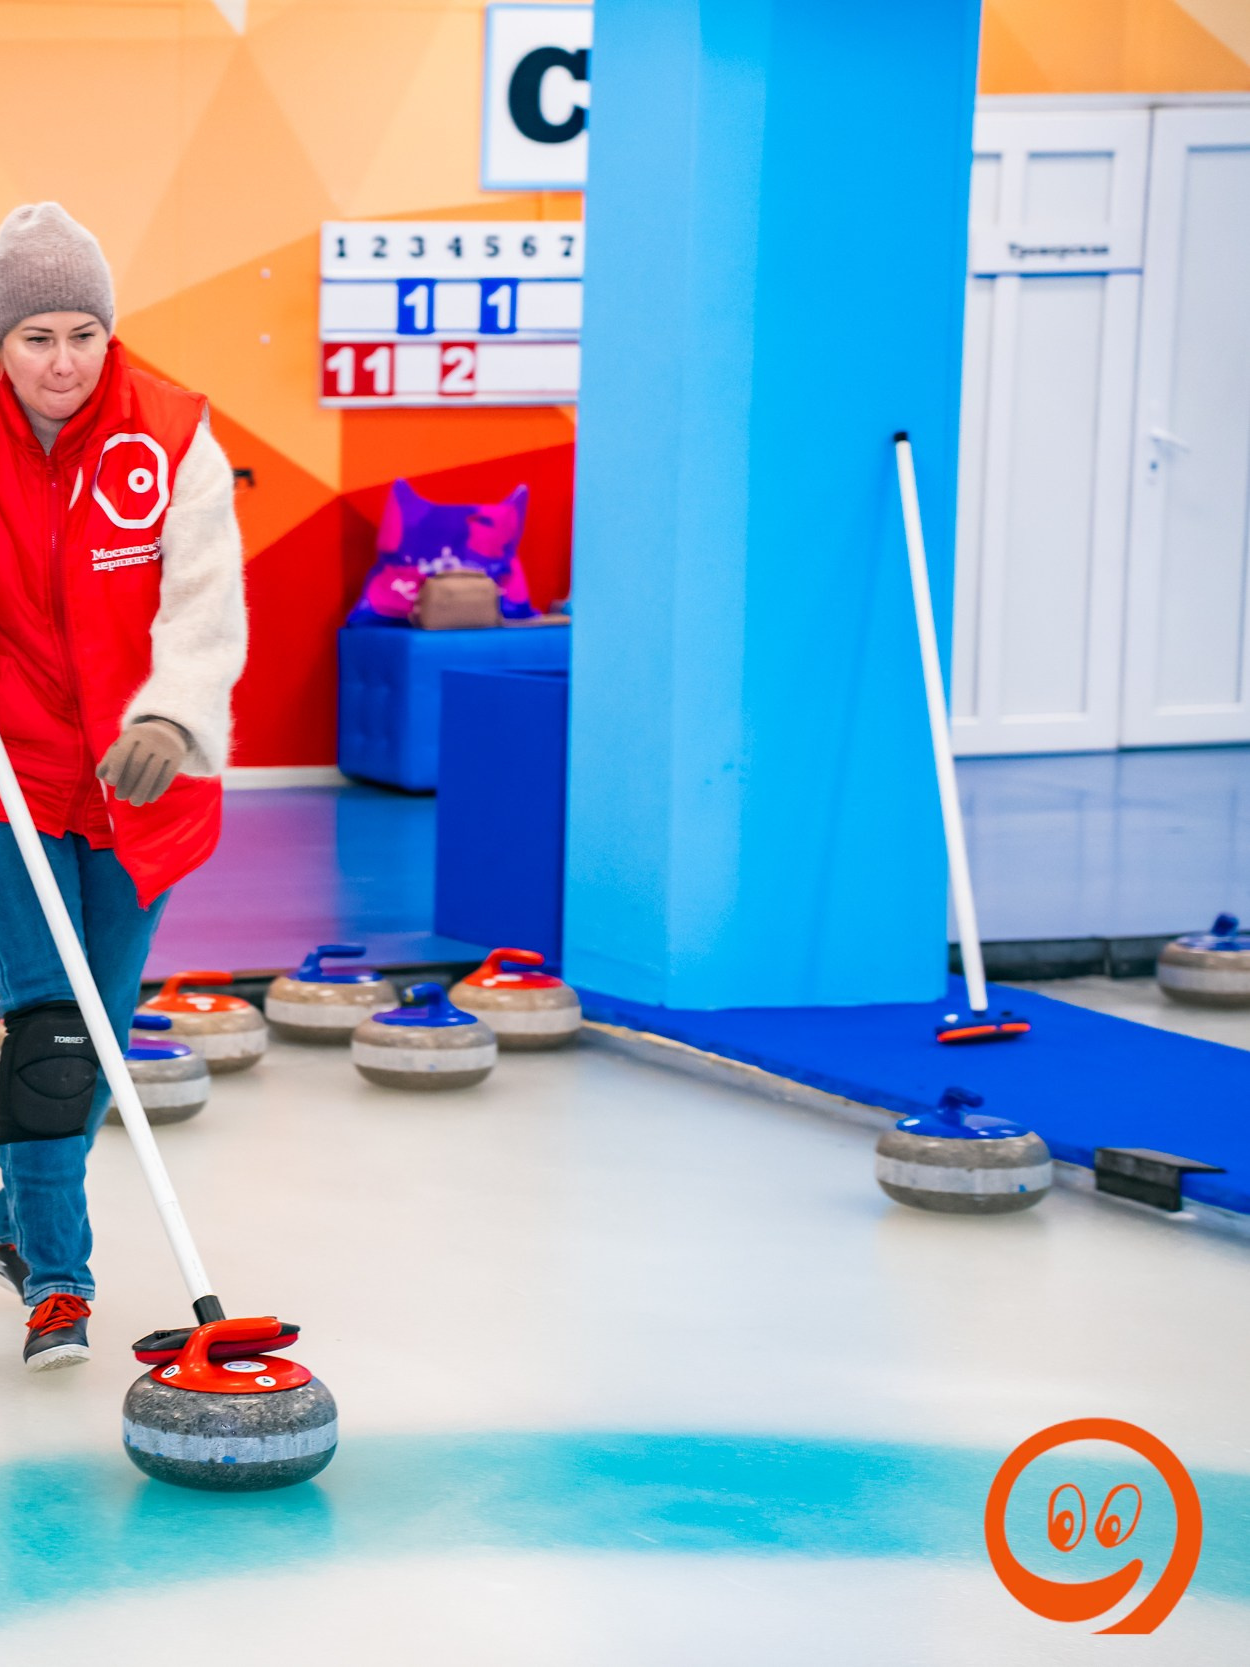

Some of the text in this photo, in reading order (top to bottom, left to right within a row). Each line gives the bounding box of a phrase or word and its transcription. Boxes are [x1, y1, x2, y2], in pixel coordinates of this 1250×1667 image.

[508, 46, 589, 143] C
[336, 235, 575, 258] 1 2 3 4 5 6 7
[403, 284, 512, 330] 1 1
[440, 346, 475, 394] 2
